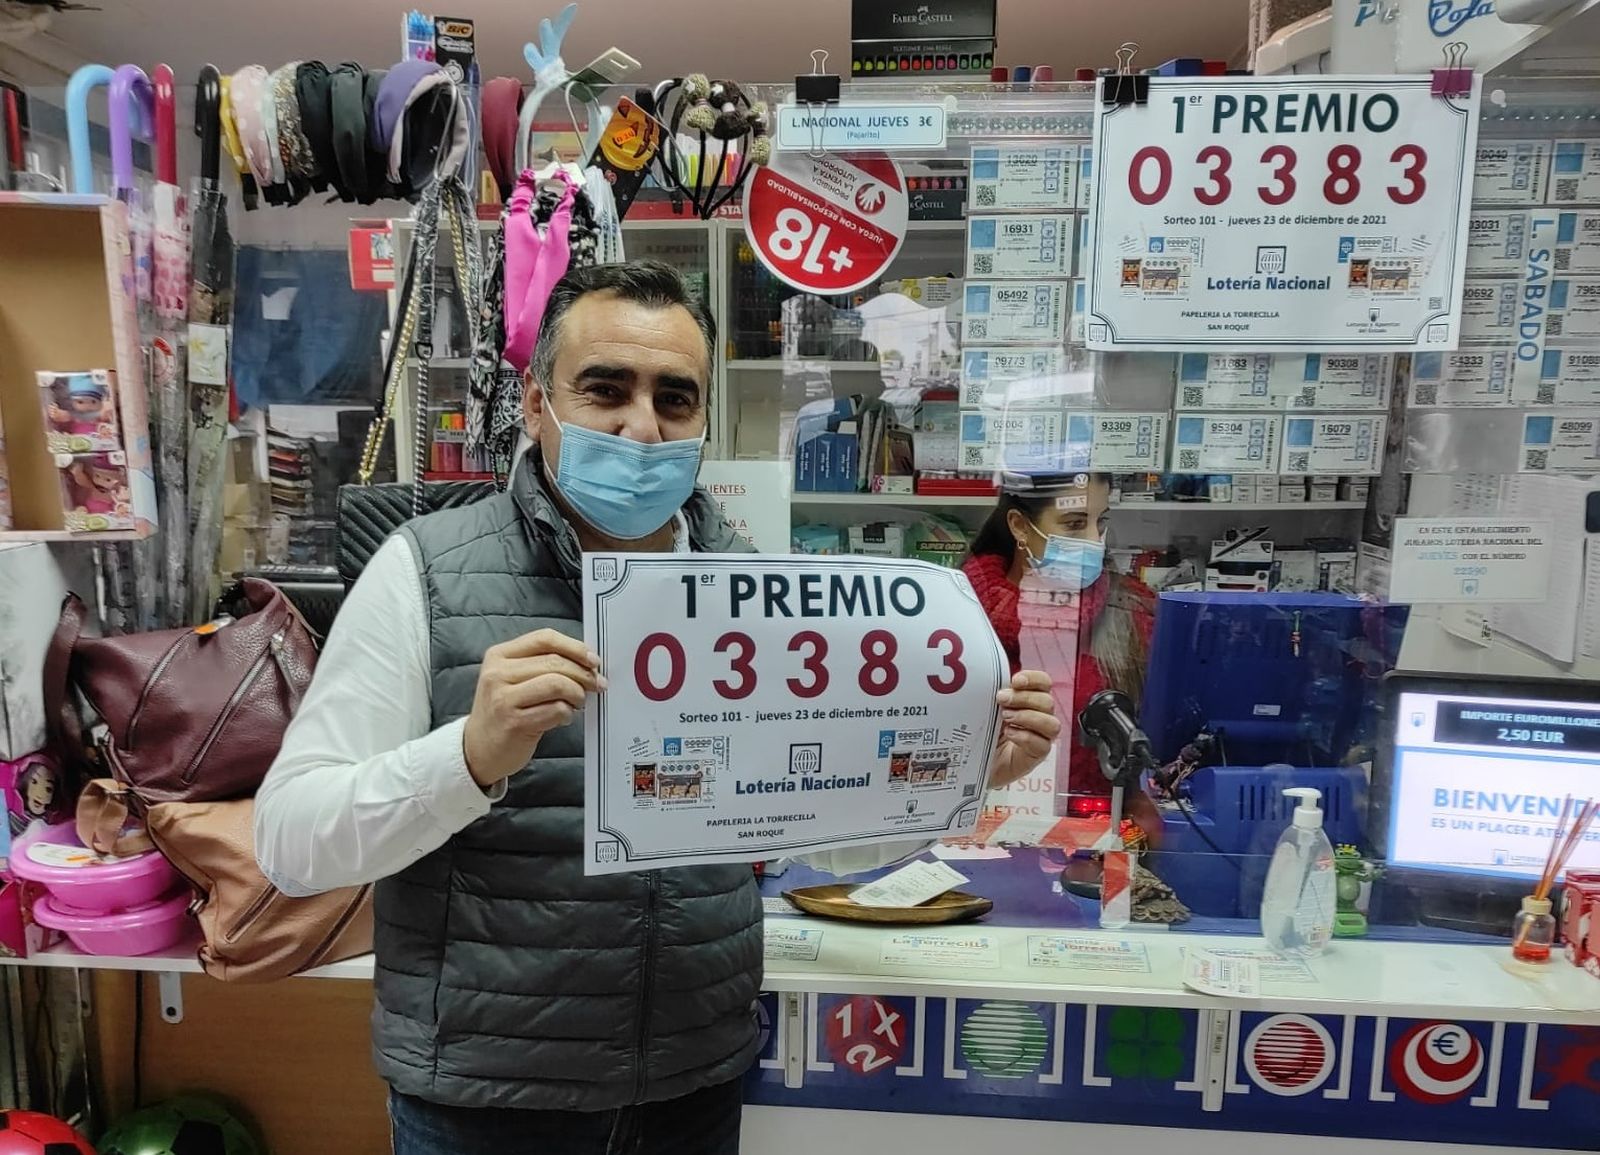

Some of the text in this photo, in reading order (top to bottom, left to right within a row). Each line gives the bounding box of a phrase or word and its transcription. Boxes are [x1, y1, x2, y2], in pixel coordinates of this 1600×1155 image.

[446, 24, 470, 34] BIC
[1212, 93, 1400, 133] PREMIO
[792, 116, 932, 129] L.NACIONAL JUEVES 3€
[846, 130, 880, 140] (Pajarito)
[819, 169, 843, 186] VENTA
[811, 176, 850, 201] PROHIBIDA
[767, 178, 884, 244] JUEGA CON RESPONSABILIDAD
[1164, 216, 1196, 226] Sorteo
[1200, 216, 1216, 226] 101
[1228, 216, 1261, 228] jueves
[1264, 216, 1276, 226] 23
[1279, 216, 1292, 226] de
[1294, 215, 1344, 226] diciembre
[1347, 215, 1360, 226] de
[1362, 215, 1386, 226] 2021
[1004, 224, 1033, 234] 16931
[768, 208, 854, 274] +18
[1207, 276, 1330, 291] Lotería Nacional
[1518, 220, 1554, 361] L. SABADO
[998, 290, 1028, 300] 05492
[1102, 422, 1132, 430] 93309
[1211, 423, 1242, 432] 95304
[1432, 526, 1452, 534] ESTE
[1454, 526, 1531, 534] ESTABLECIMIENTO
[1482, 538, 1524, 546] NACIONAL
[730, 574, 926, 618] PREMIO
[680, 712, 718, 723] Sorteo
[722, 712, 742, 722] 101
[756, 711, 792, 723] jueves
[795, 710, 809, 720] 23
[812, 709, 826, 720] de
[828, 707, 883, 718] diciembre
[886, 706, 900, 716] de
[902, 706, 928, 716] 2021
[1460, 710, 1513, 722] IMPORTE
[1532, 730, 1565, 744] EUR
[736, 772, 871, 795] Lotería Nacional
[706, 814, 816, 828] PAPELERIA LA TORRECILLA
[1432, 818, 1446, 828] ES
[1451, 820, 1473, 830] UN
[1478, 822, 1530, 835] PLACER
[738, 829, 784, 839] SAN ROQUE
[835, 1000, 900, 1048] 1 X
[845, 1043, 894, 1073] 2
